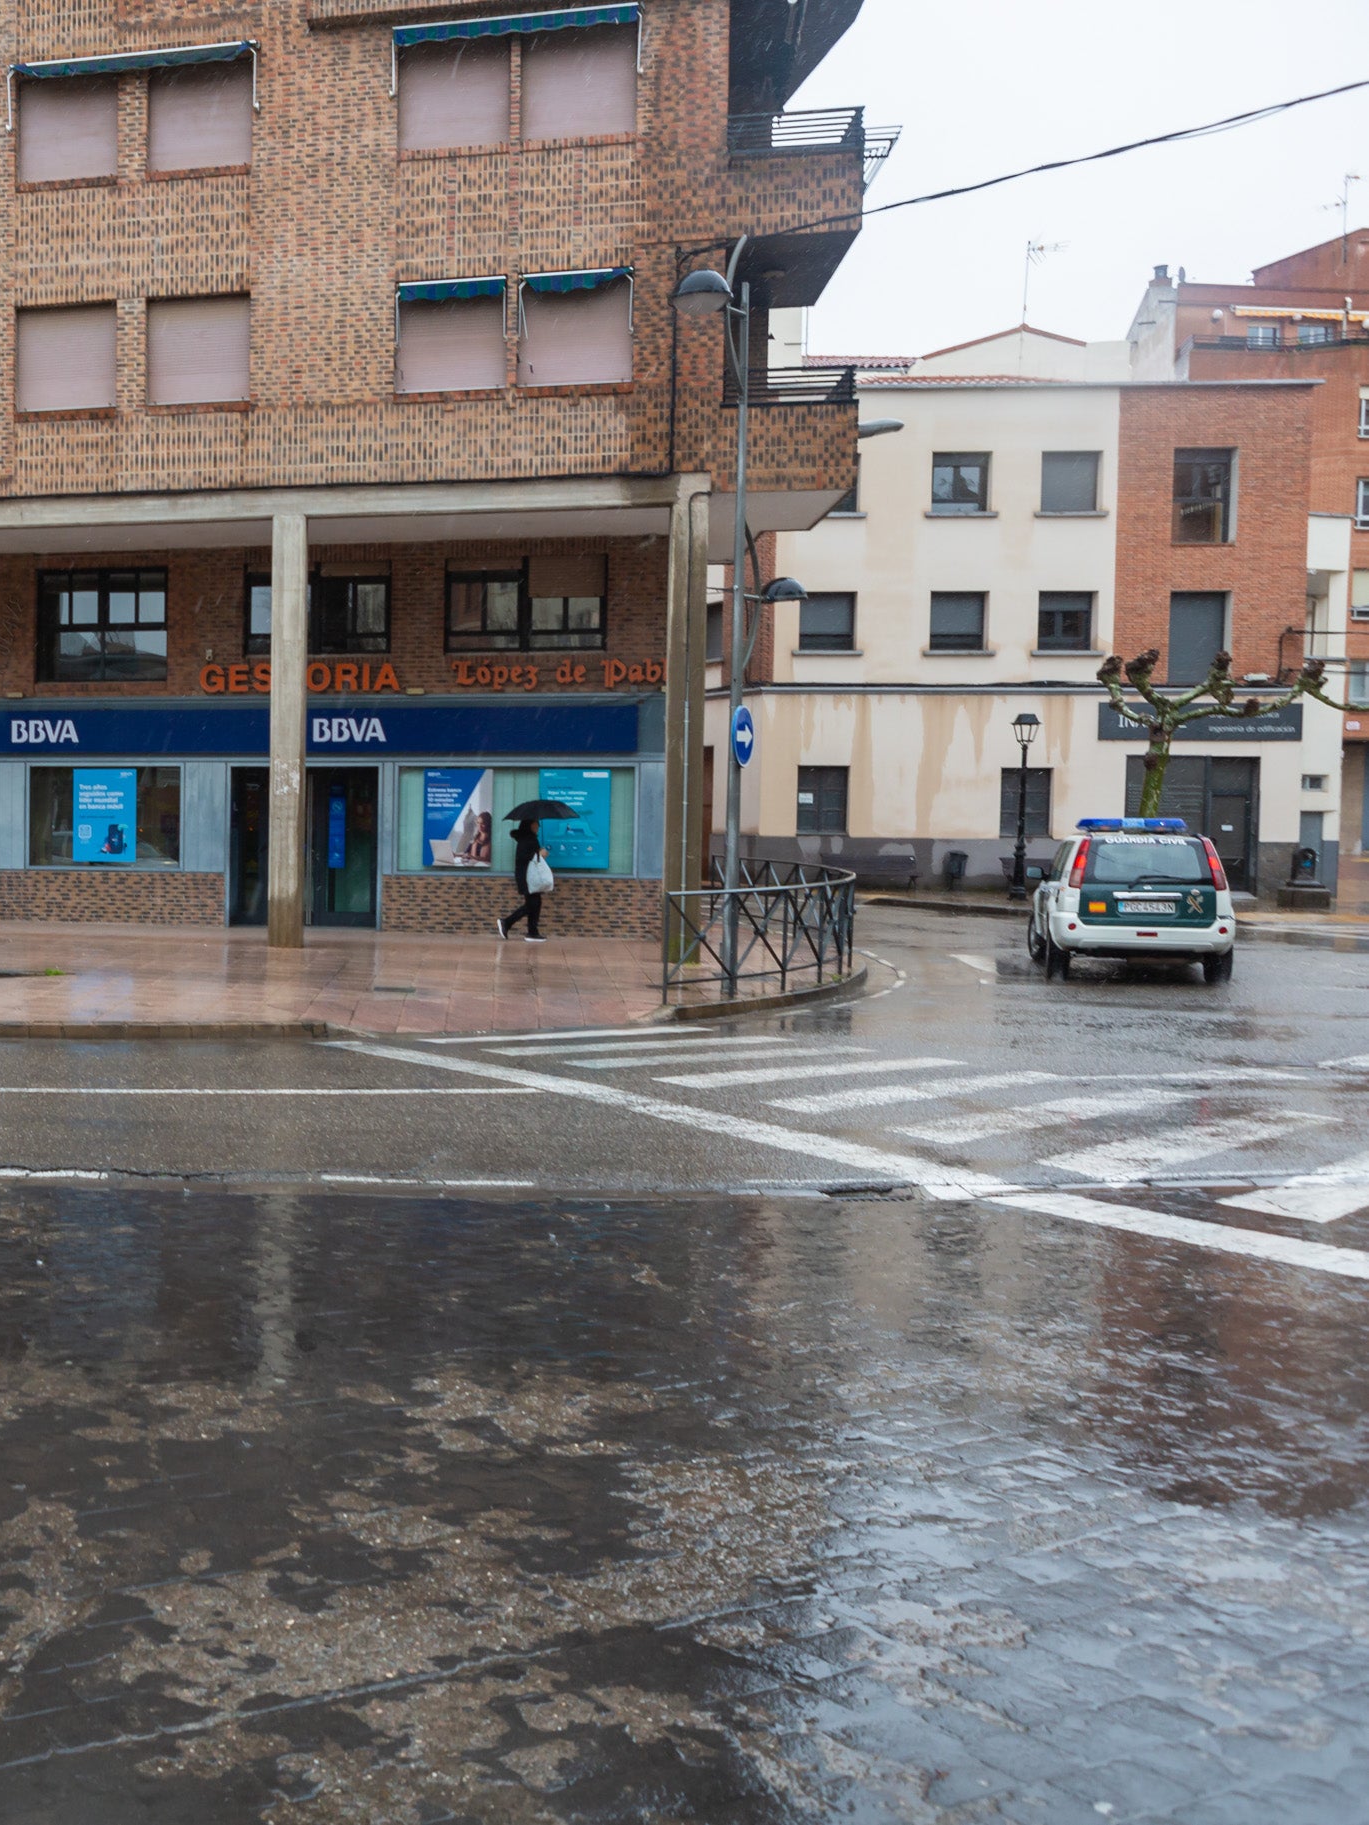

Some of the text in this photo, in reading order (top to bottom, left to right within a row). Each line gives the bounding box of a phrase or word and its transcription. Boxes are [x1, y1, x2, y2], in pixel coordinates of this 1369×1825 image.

[199, 662, 400, 693] GESORIA
[452, 658, 667, 690] López de Pabl
[11, 719, 79, 744] BBVA
[312, 717, 386, 743] BBVA
[1105, 836, 1188, 847] GUARDIA CIVIL
